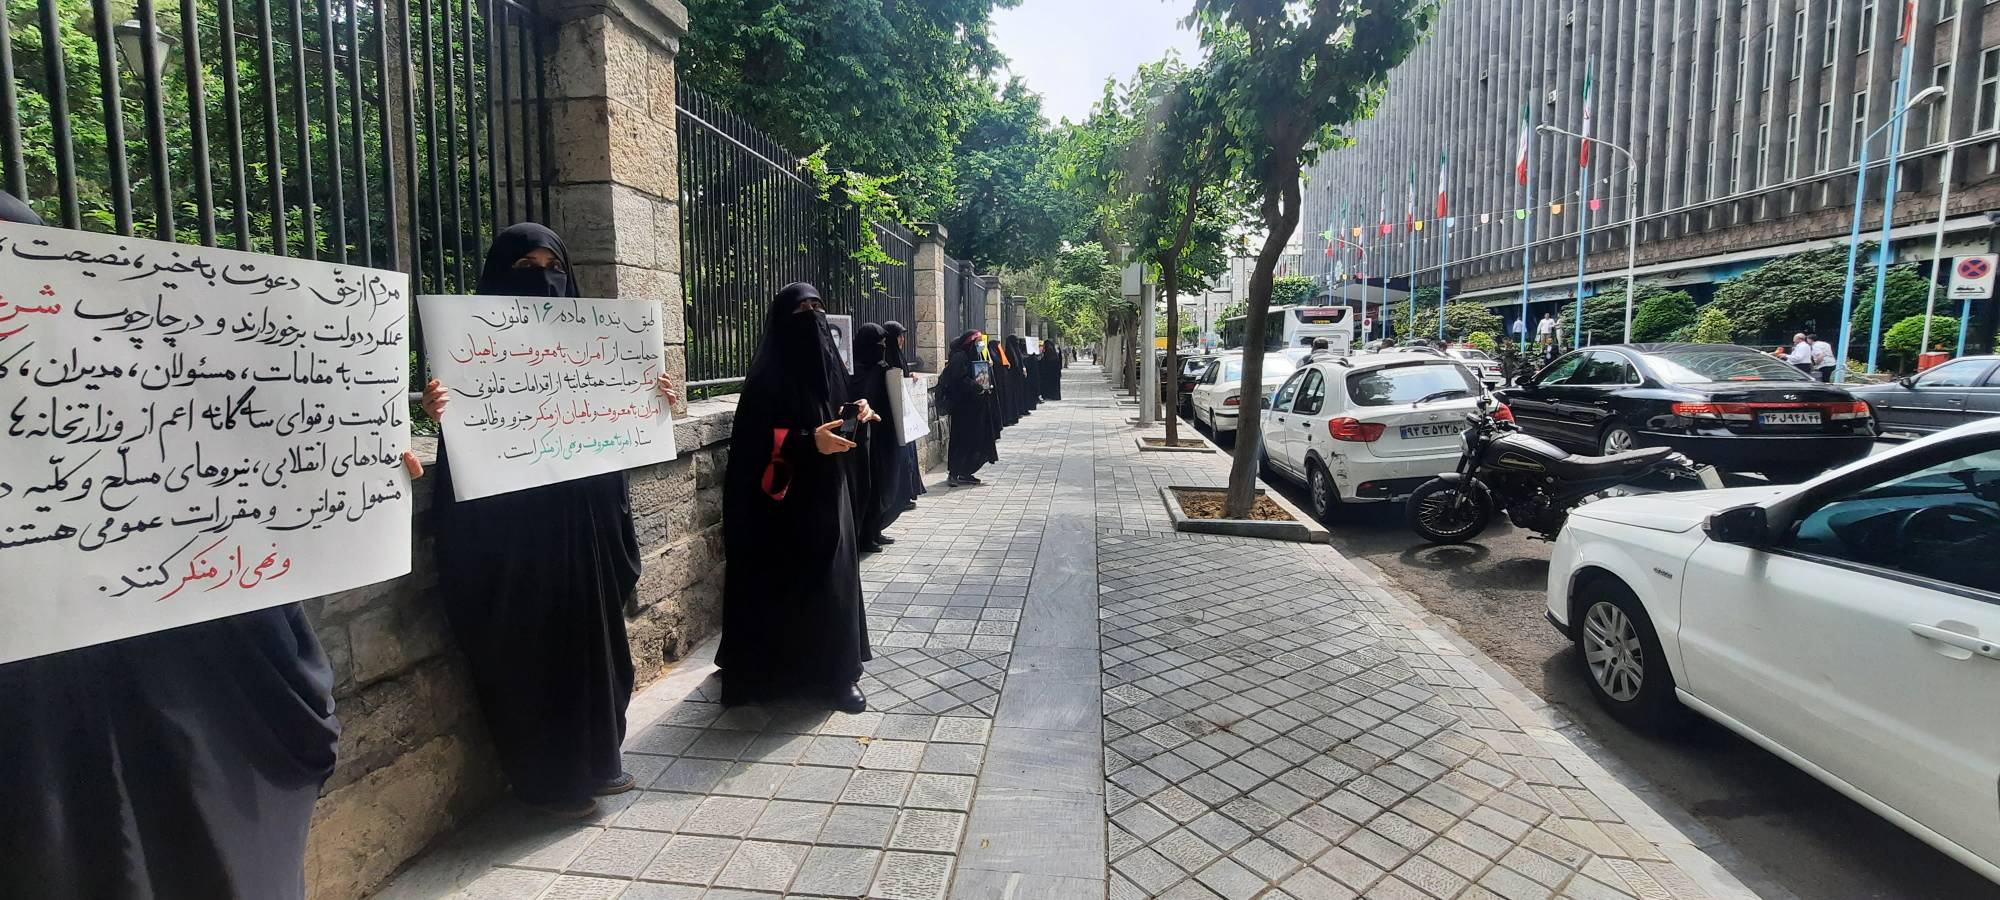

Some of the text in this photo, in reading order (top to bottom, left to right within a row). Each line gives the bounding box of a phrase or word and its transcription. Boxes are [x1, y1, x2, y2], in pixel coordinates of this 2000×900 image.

[191, 255, 216, 287] به
[222, 263, 301, 296] دعوت
[345, 273, 367, 308] از
[368, 274, 400, 322] مردم
[74, 293, 184, 350] چارچوب
[163, 313, 205, 336] در
[202, 316, 226, 337] و
[471, 298, 530, 333] قانون
[533, 301, 554, 324] ۱۶
[550, 299, 587, 325] ماده
[622, 306, 656, 334] طبق
[201, 305, 307, 349] برخوردارند
[313, 314, 363, 349] دولت
[360, 314, 405, 356] عملکرد
[447, 332, 659, 368] حمایت از آمران به معروف و ناهیان
[336, 362, 351, 391] به
[353, 366, 400, 395] نسبت
[451, 371, 506, 400] قانونی
[507, 371, 553, 395] اقدامات
[546, 371, 563, 397] از
[605, 366, 639, 393] حمایت
[630, 363, 658, 394] منکر
[645, 371, 660, 392] از
[202, 384, 257, 431] گانه
[240, 399, 275, 429] سه
[276, 397, 326, 437] قوای
[339, 386, 406, 437] حاکمیت
[463, 401, 506, 432] وظایف
[527, 396, 555, 432] منکر
[547, 402, 561, 429] از
[562, 399, 592, 426] ناهیان
[590, 409, 599, 423] و
[596, 405, 633, 424] معروف
[628, 400, 638, 419] به
[637, 394, 663, 419] آمران
[121, 401, 156, 445] از
[158, 397, 195, 464] اعم
[317, 416, 335, 434] و
[633, 426, 653, 448] ستاد
[529, 427, 556, 466] منکر
[551, 435, 563, 459] از
[562, 433, 577, 460] نهی
[575, 441, 583, 454] و
[582, 435, 616, 455] معروف
[616, 428, 632, 453] امر
[164, 440, 251, 493] نیروهای
[60, 476, 93, 503] و
[0, 478, 402, 552] مشمول قوانین و مقررات عمومی هستن
[155, 535, 229, 602] منکر
[203, 544, 243, 593] از
[239, 542, 279, 589] نهی
[265, 557, 291, 581] و
